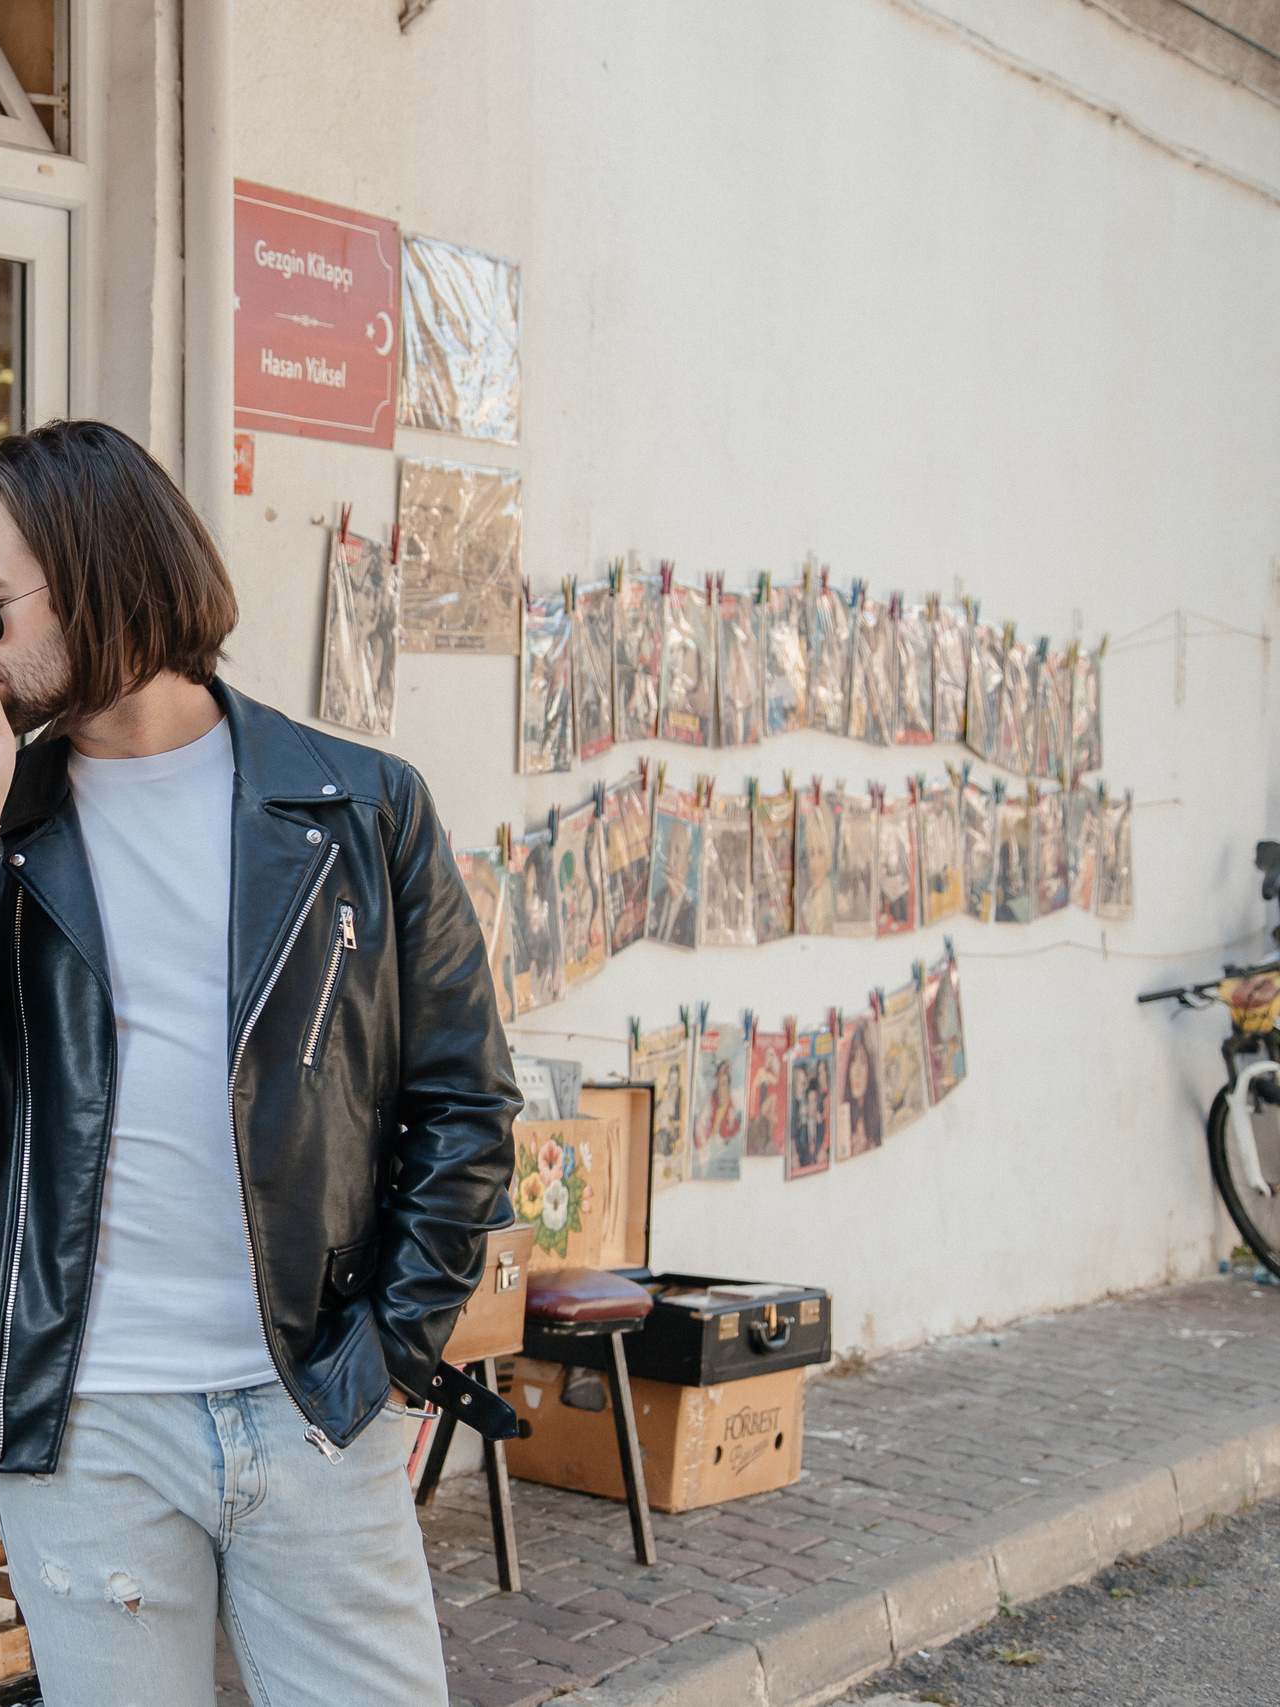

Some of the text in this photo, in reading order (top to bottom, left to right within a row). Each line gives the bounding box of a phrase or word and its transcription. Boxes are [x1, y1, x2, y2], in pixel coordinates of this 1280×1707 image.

[254, 239, 353, 293] Gezgin Kitapçı
[260, 347, 347, 389] Hasan Yüksel
[724, 1405, 780, 1441] FORBEST
